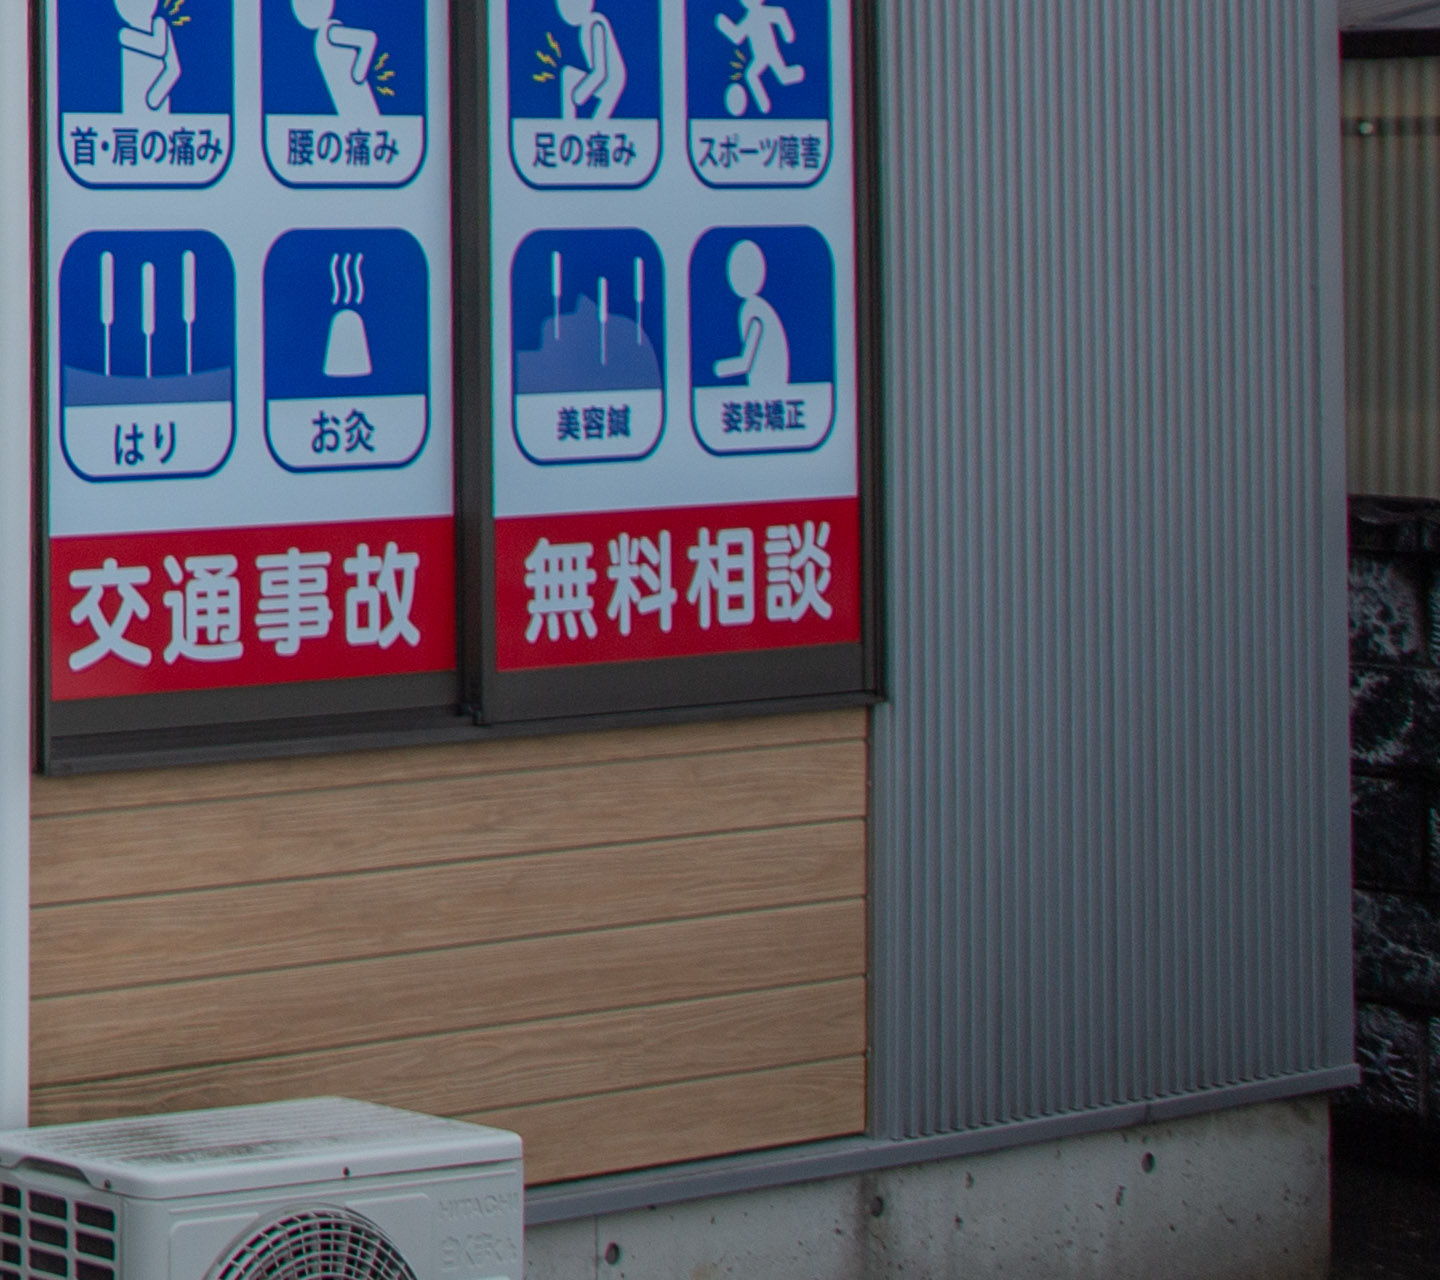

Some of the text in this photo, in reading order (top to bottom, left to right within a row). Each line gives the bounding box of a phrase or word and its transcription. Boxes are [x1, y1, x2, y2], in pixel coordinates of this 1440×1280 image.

[71, 127, 222, 165] 首・肩の痛み
[288, 129, 399, 166] 腰の痛み
[534, 131, 637, 168] 足の痛み
[699, 133, 821, 169] スポーツ障害
[115, 422, 177, 466] はり
[311, 410, 376, 454] お灸
[69, 521, 832, 672] 交通事故 無料相談
